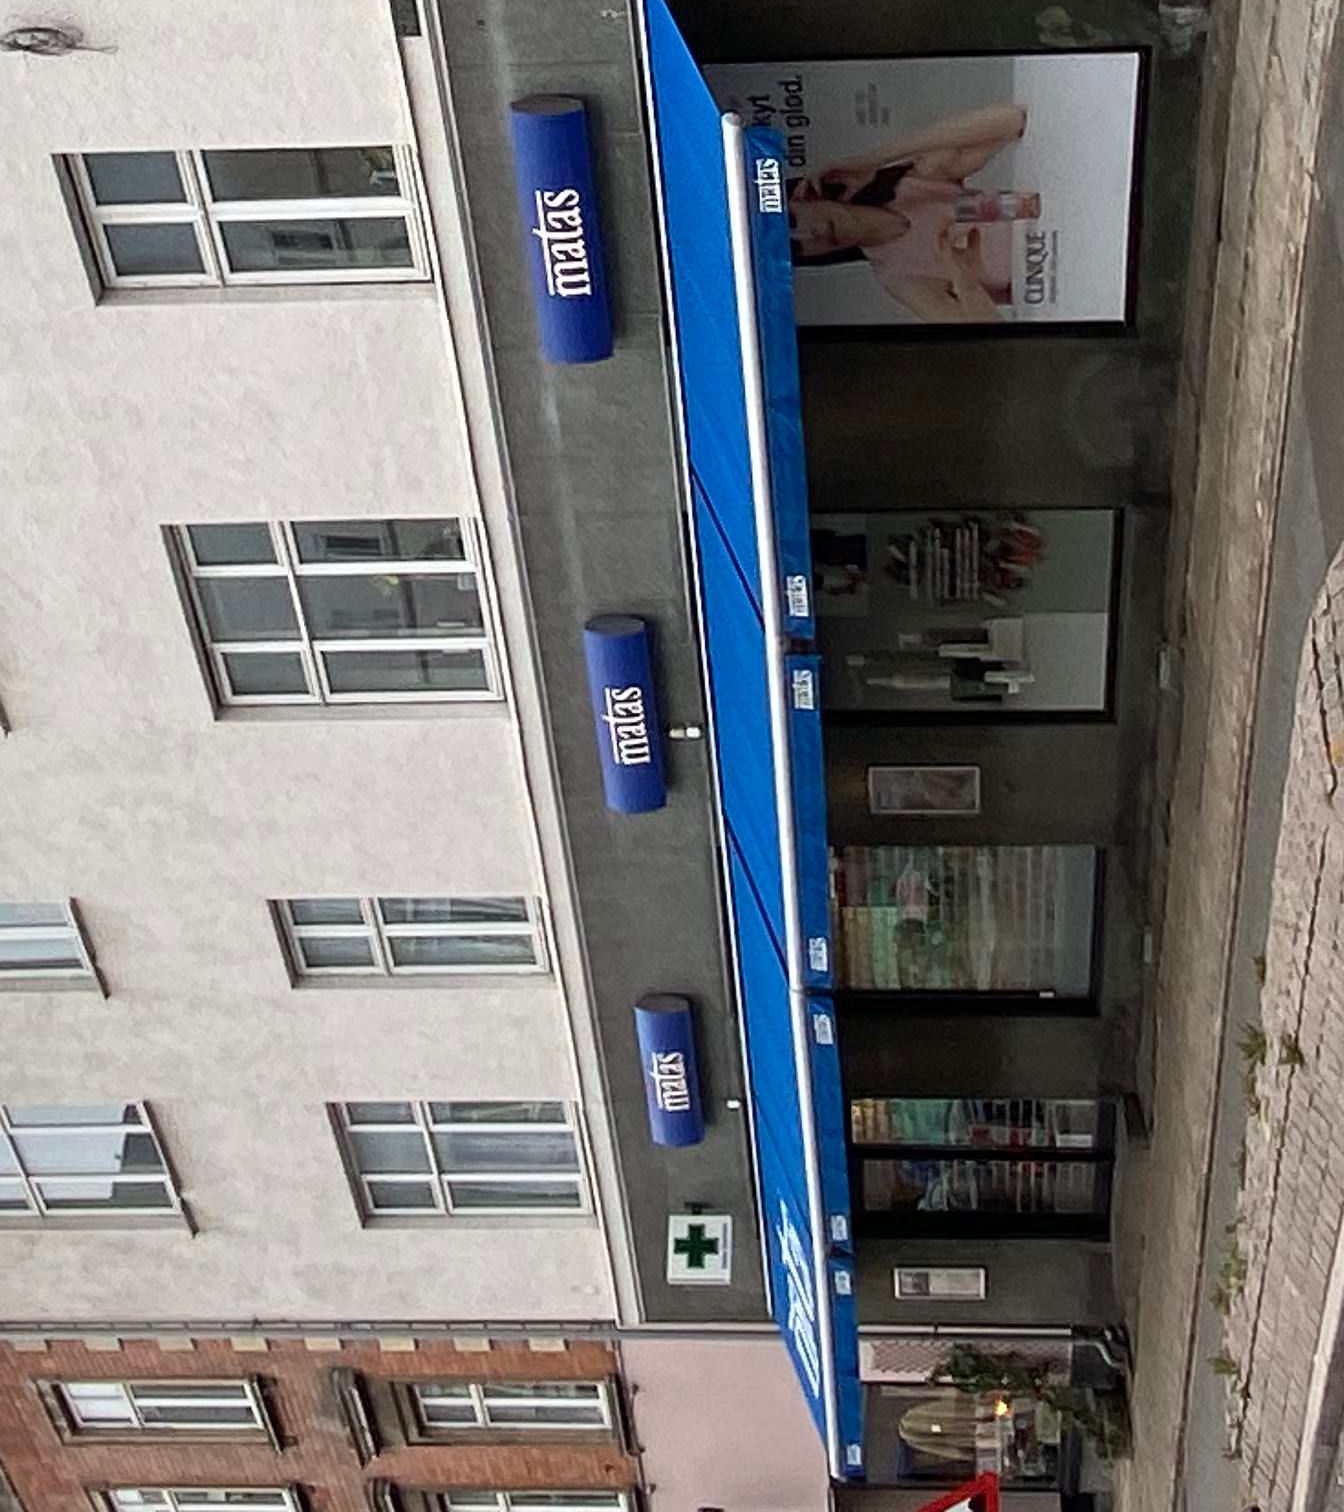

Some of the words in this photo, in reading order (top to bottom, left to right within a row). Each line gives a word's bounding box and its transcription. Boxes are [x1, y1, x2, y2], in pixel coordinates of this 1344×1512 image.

[746, 95, 776, 127] kyt
[783, 135, 806, 167] din
[531, 189, 592, 297] matas
[1024, 231, 1049, 304] CLINIQUE
[602, 687, 651, 764] matas
[648, 1052, 690, 1111] matas
